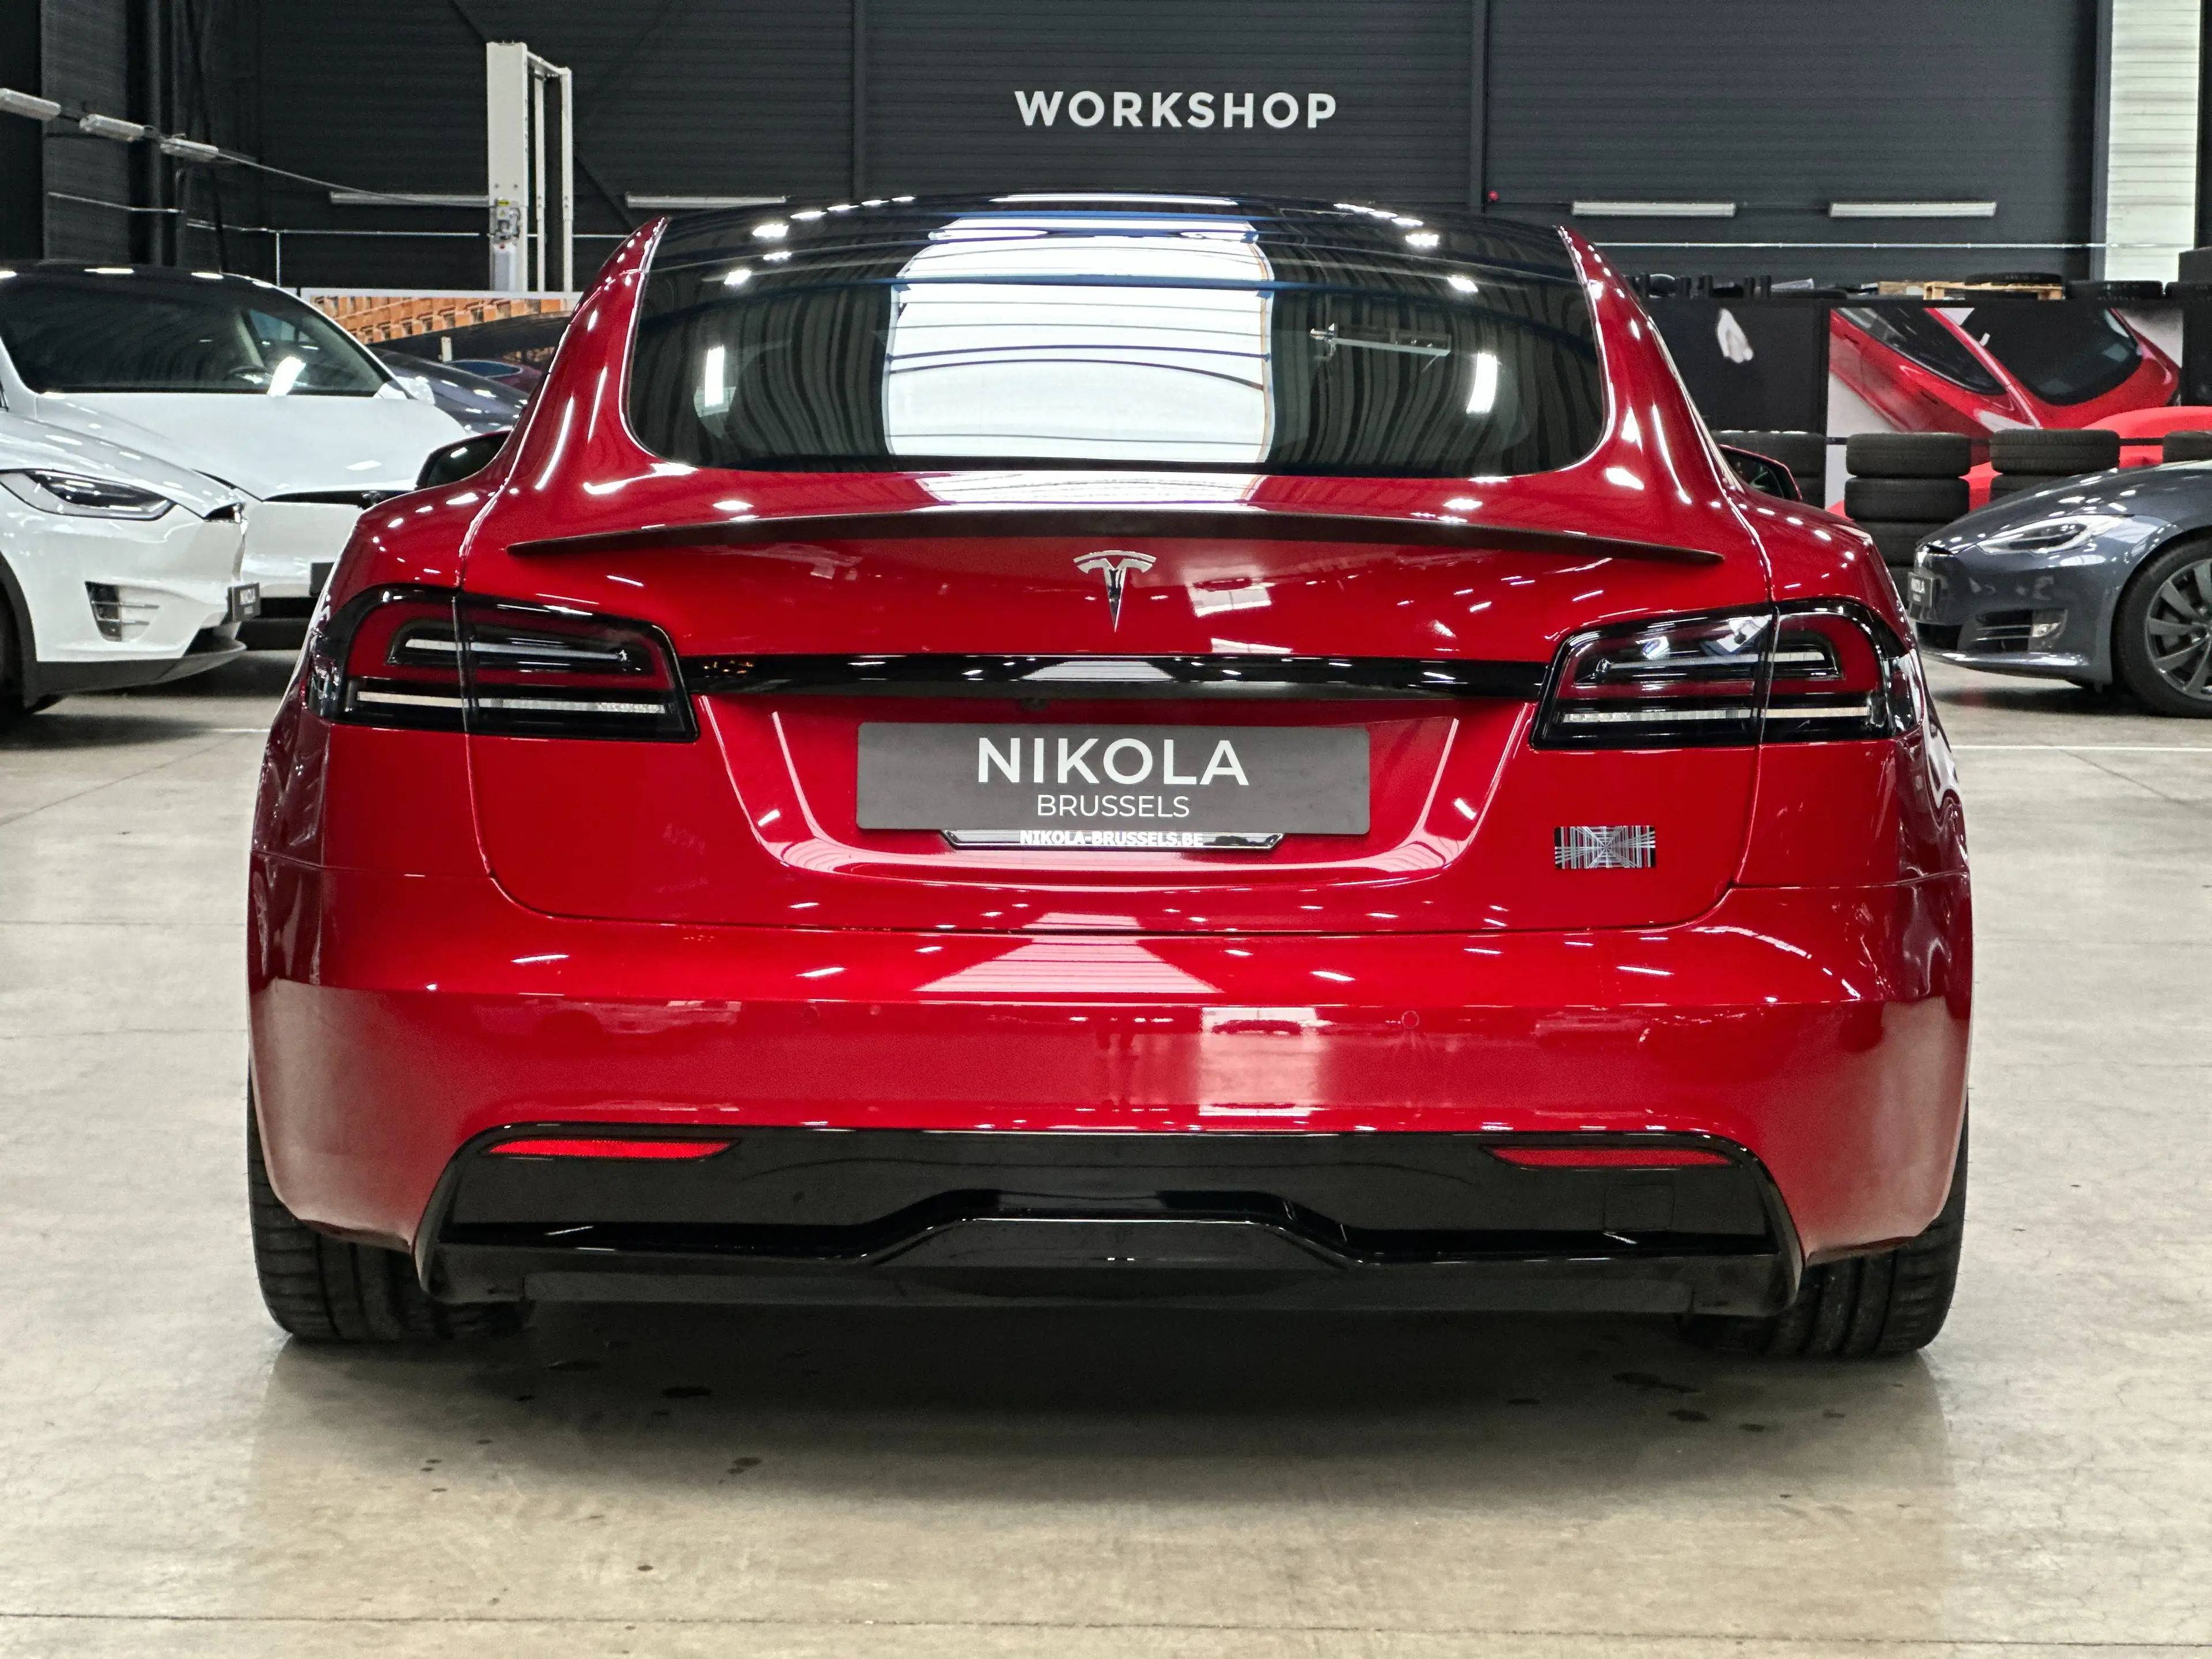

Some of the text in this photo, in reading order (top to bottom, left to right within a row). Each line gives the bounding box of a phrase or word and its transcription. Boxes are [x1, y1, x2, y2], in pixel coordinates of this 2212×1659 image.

[1014, 90, 1336, 128] WORKSHOP
[978, 737, 1249, 786] NIKOLA
[1037, 794, 1190, 818] BRUSSELS
[1020, 830, 1203, 846] NIKOLA-BRUSSELS.BE
